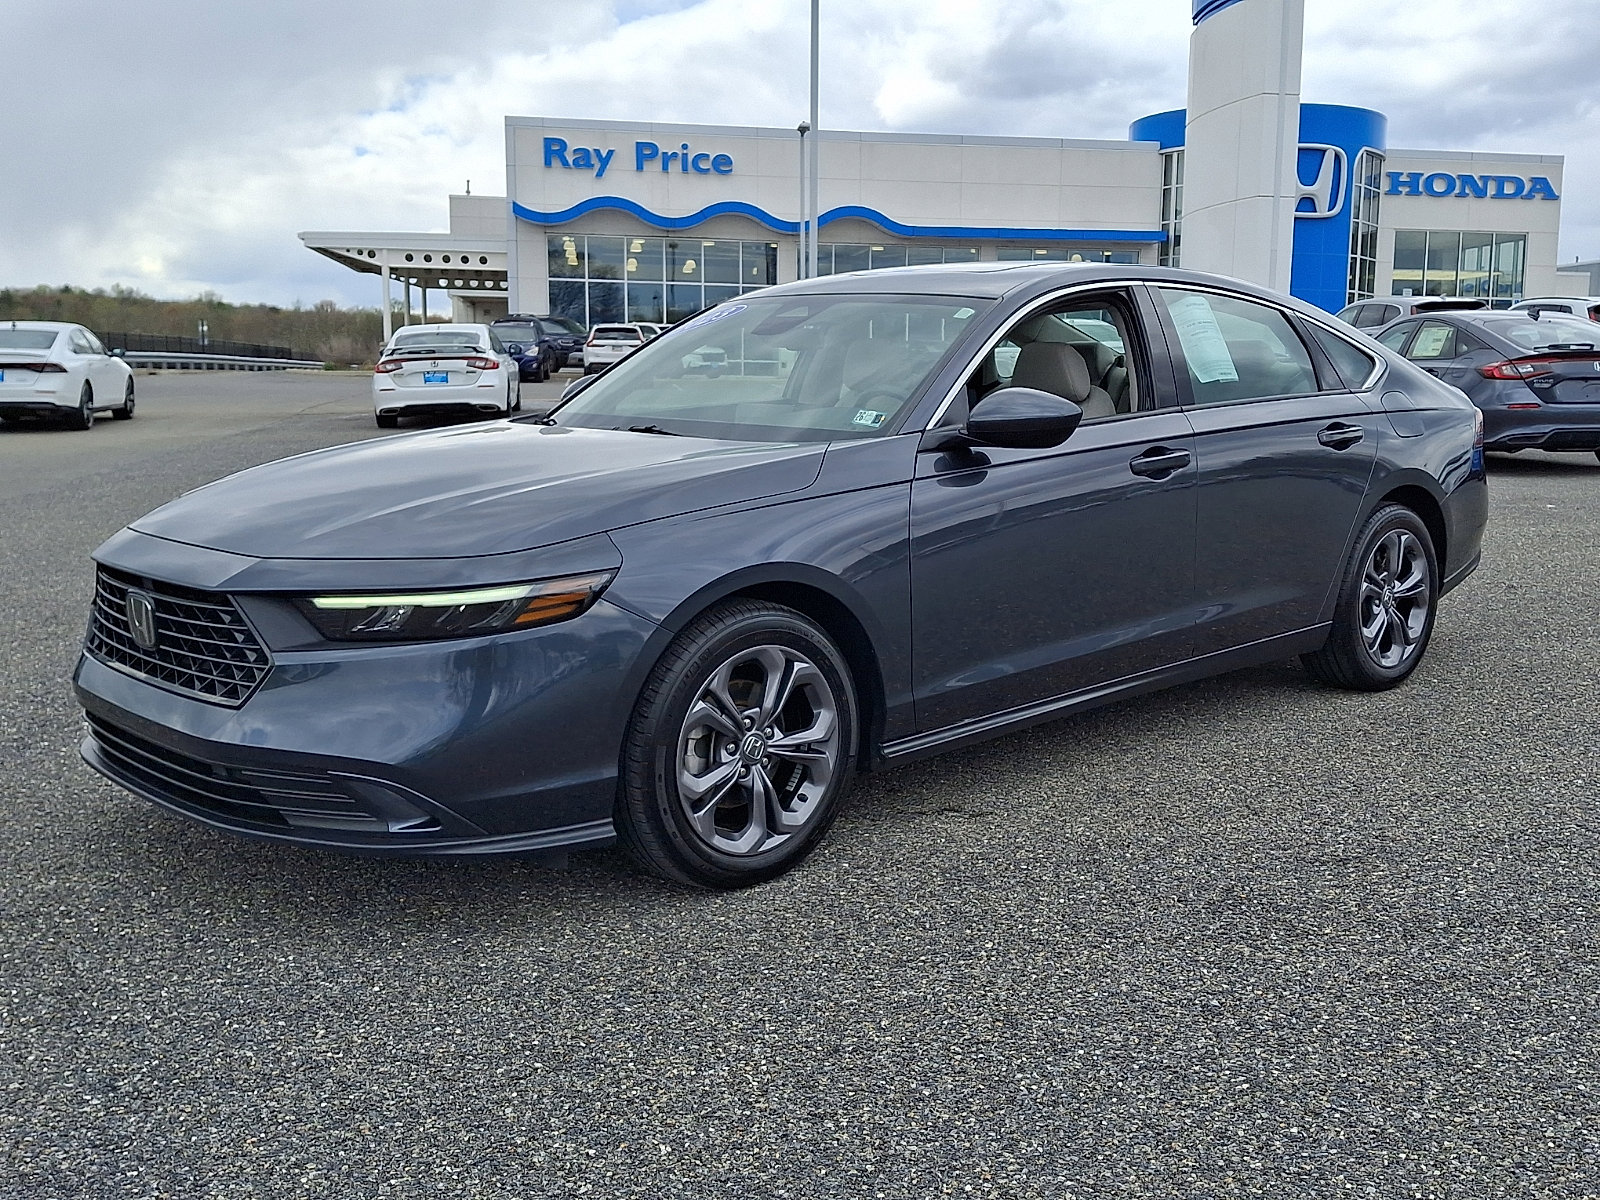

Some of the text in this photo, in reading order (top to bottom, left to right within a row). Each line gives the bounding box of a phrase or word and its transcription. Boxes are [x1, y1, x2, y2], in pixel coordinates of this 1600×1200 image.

[543, 137, 734, 178] Ray Price
[1385, 171, 1560, 200] HONDA
